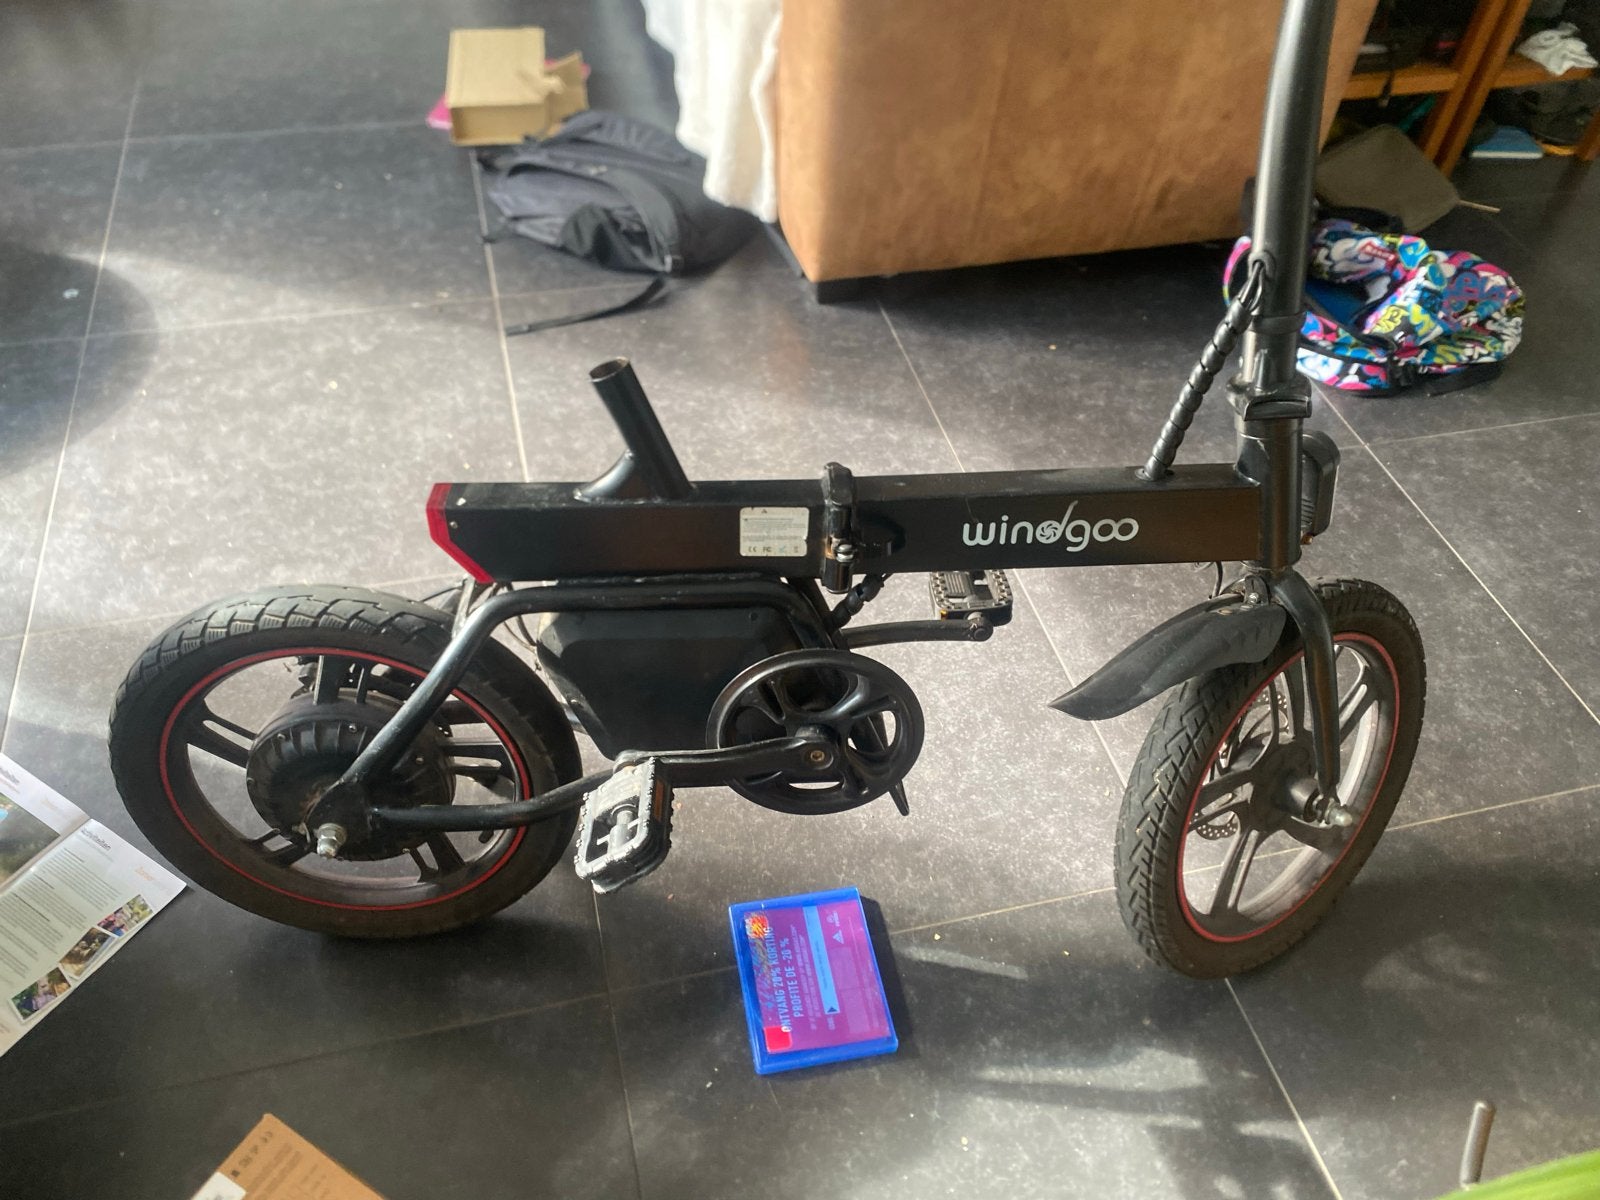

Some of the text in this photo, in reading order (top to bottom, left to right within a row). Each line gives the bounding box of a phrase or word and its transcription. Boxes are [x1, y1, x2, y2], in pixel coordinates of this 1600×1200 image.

[963, 501, 1139, 552] windgoo
[764, 926, 792, 1033] ONTVANG 20% KORTING
[784, 965, 796, 978] DE
[788, 980, 804, 1017] PROFITE
